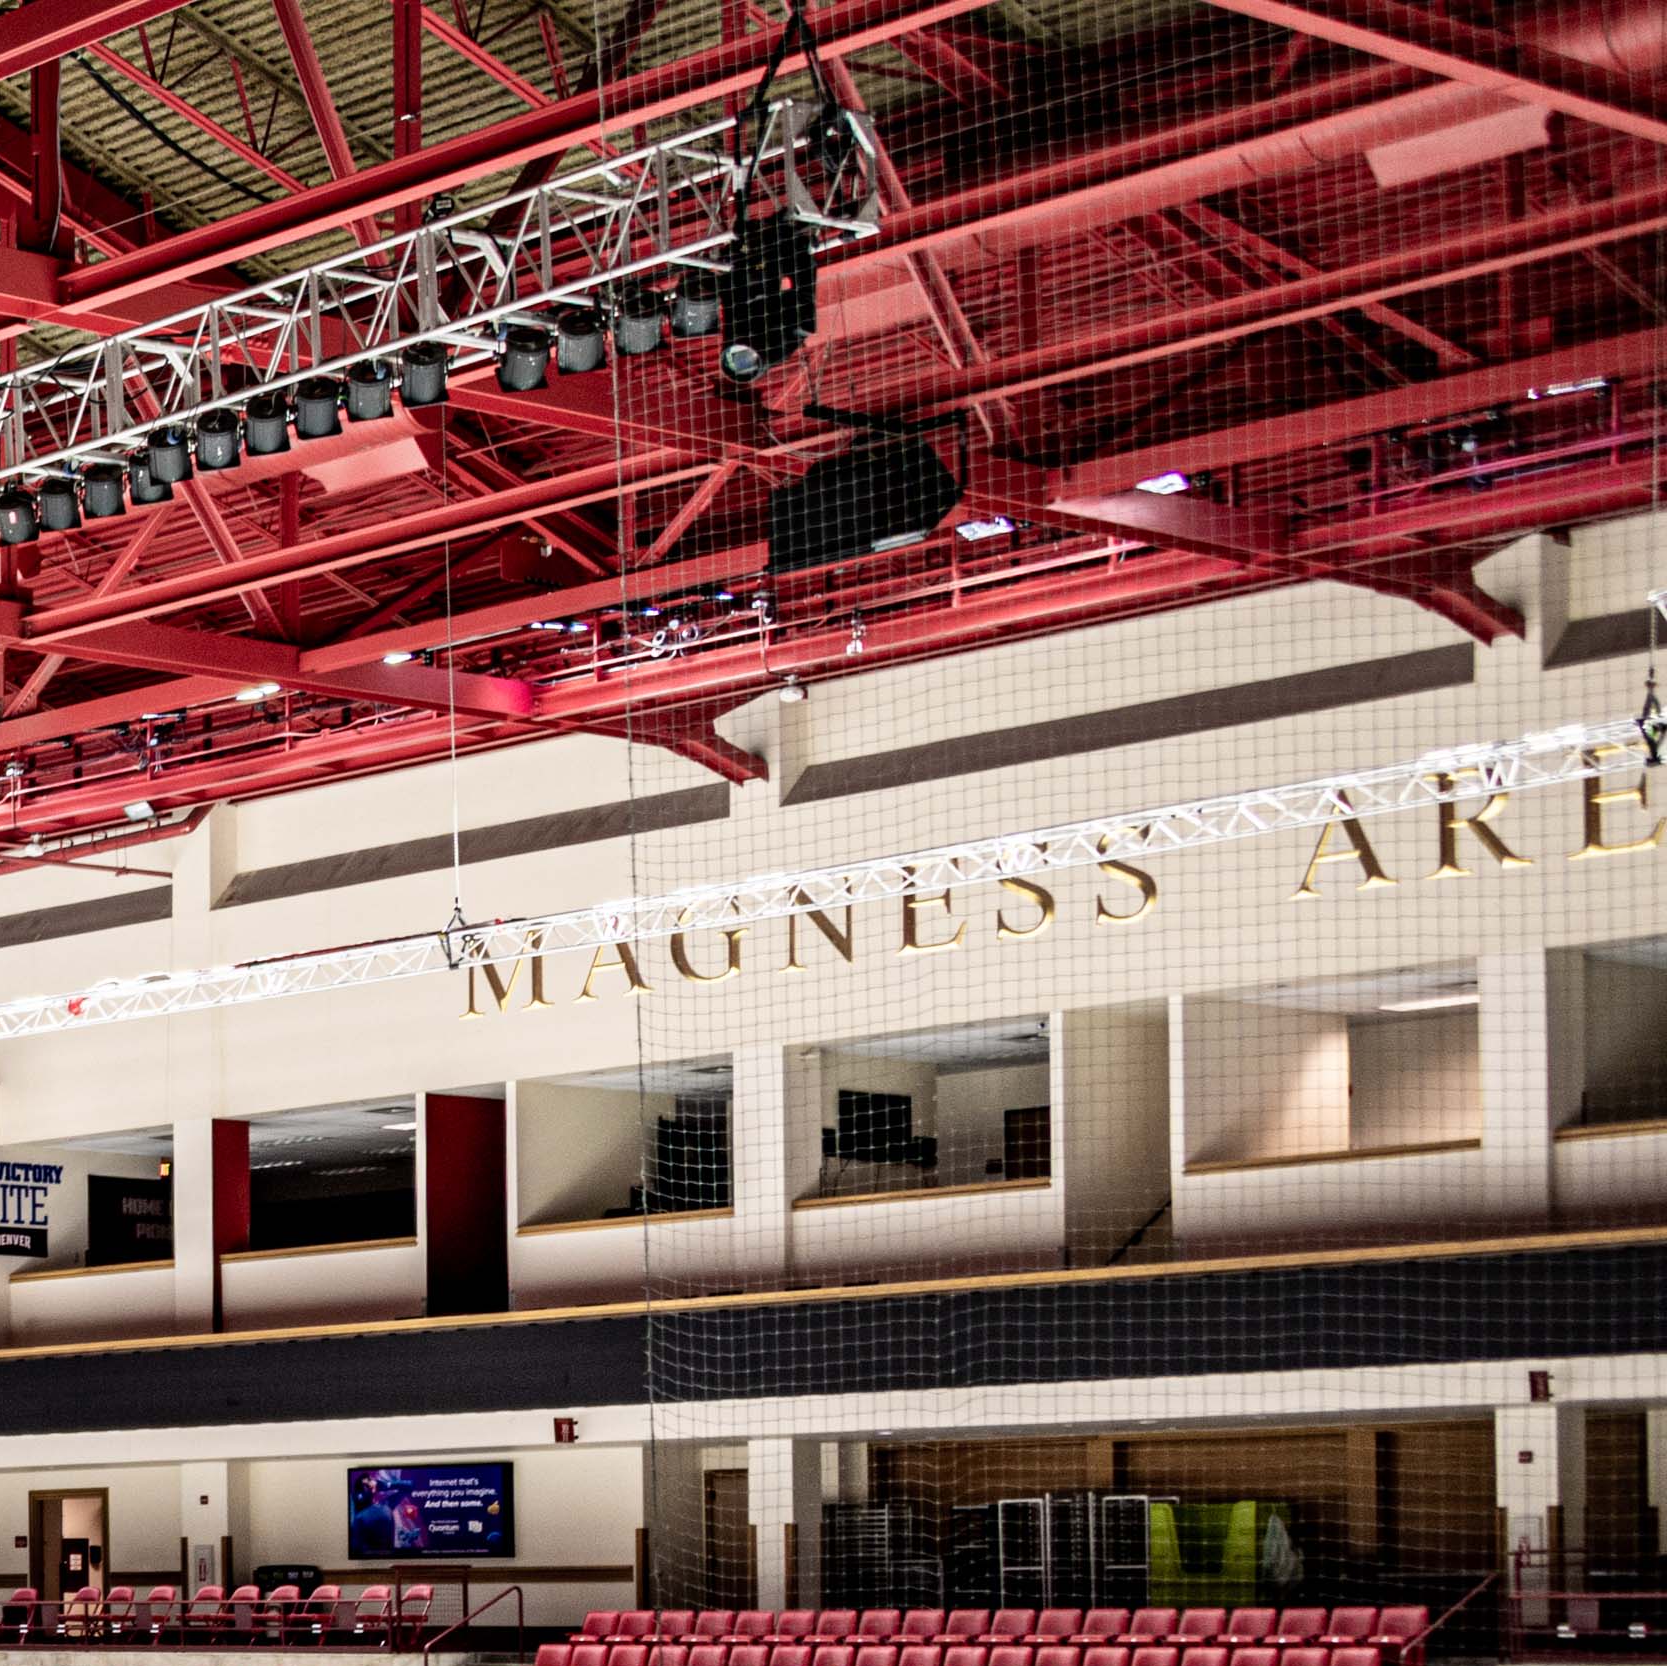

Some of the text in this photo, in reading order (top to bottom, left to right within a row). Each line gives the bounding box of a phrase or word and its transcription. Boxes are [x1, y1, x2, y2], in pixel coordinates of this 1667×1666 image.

[459, 824, 1158, 1018] MAGNESS
[429, 1478, 478, 1487] Internet that's
[411, 1490, 449, 1499] everything
[450, 1490, 464, 1498] you
[429, 1523, 459, 1533] Quantum
